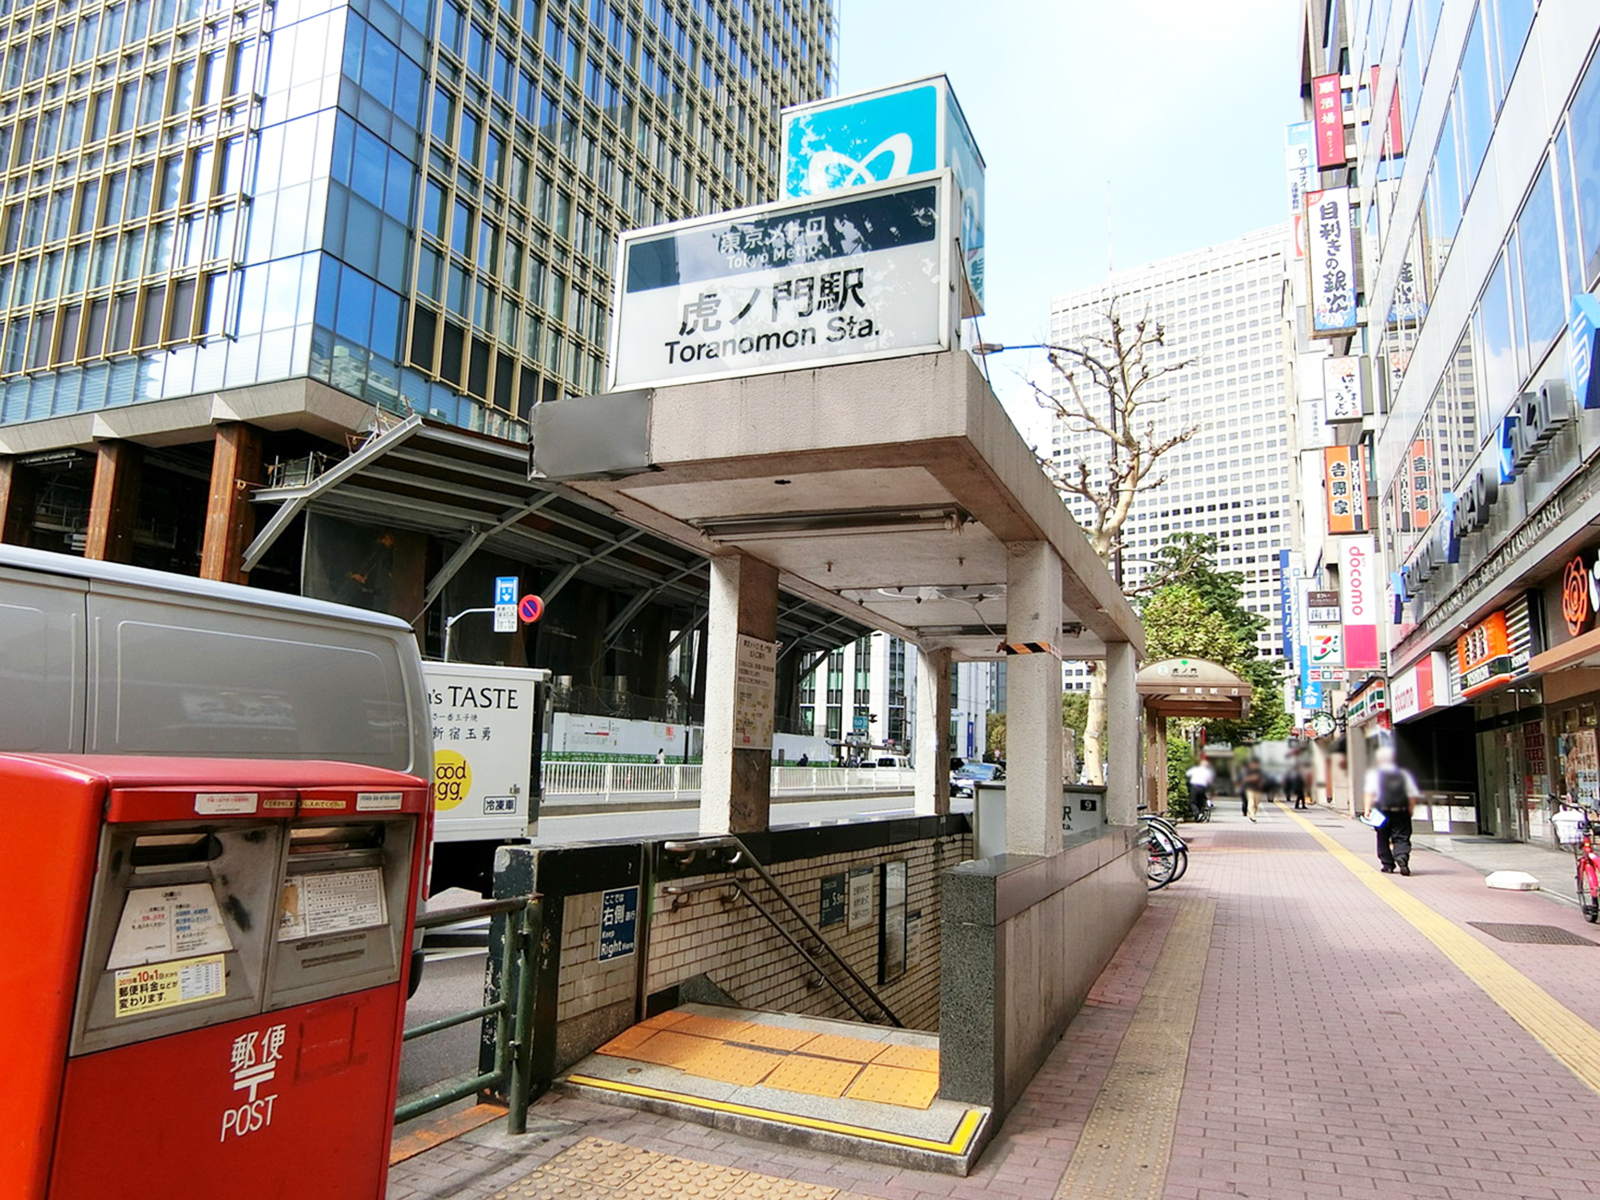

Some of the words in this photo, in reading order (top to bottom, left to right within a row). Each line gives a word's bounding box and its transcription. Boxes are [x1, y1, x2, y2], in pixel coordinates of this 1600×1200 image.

[719, 217, 826, 254] 東京メトロ
[726, 251, 769, 270] Tokyo
[773, 244, 818, 262] Metro
[1320, 201, 1348, 314] 目利きの銀次
[679, 267, 866, 336] 虎ノ門駅
[664, 326, 817, 365] Toranomon
[826, 315, 881, 343] Sta.
[1331, 462, 1349, 516] 吉野家
[1349, 546, 1366, 616] docomo
[447, 685, 519, 710] TASTE
[436, 760, 467, 780] ood
[435, 781, 463, 801] gg.
[486, 800, 514, 811] 冷凍車
[1084, 800, 1092, 810] 9
[600, 940, 622, 958] Right
[119, 981, 178, 998] 郵便料金などが
[229, 1024, 287, 1073] 郵便
[220, 1094, 279, 1143] POST
